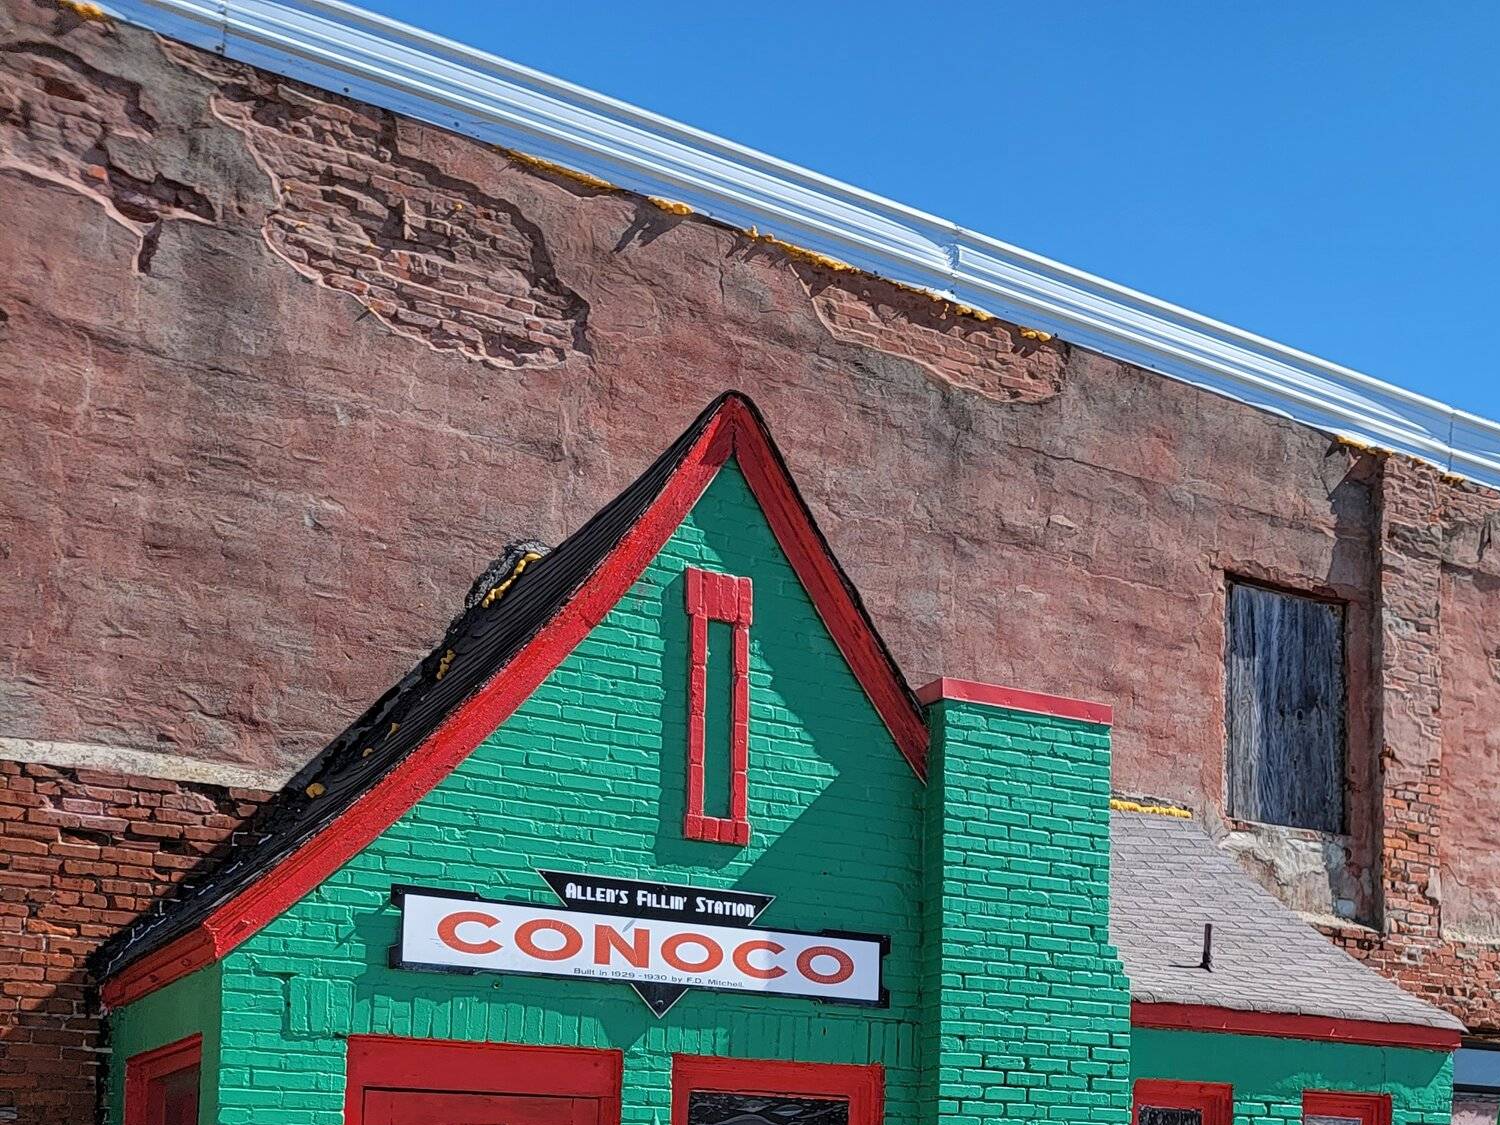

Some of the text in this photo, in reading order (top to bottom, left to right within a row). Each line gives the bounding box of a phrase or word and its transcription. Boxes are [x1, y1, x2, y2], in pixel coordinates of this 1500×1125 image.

[565, 882, 629, 905] ALLEN'S
[636, 890, 687, 911] FILLIN'
[437, 911, 855, 985] CONOCO
[573, 967, 595, 975] Built
[671, 975, 683, 983] by
